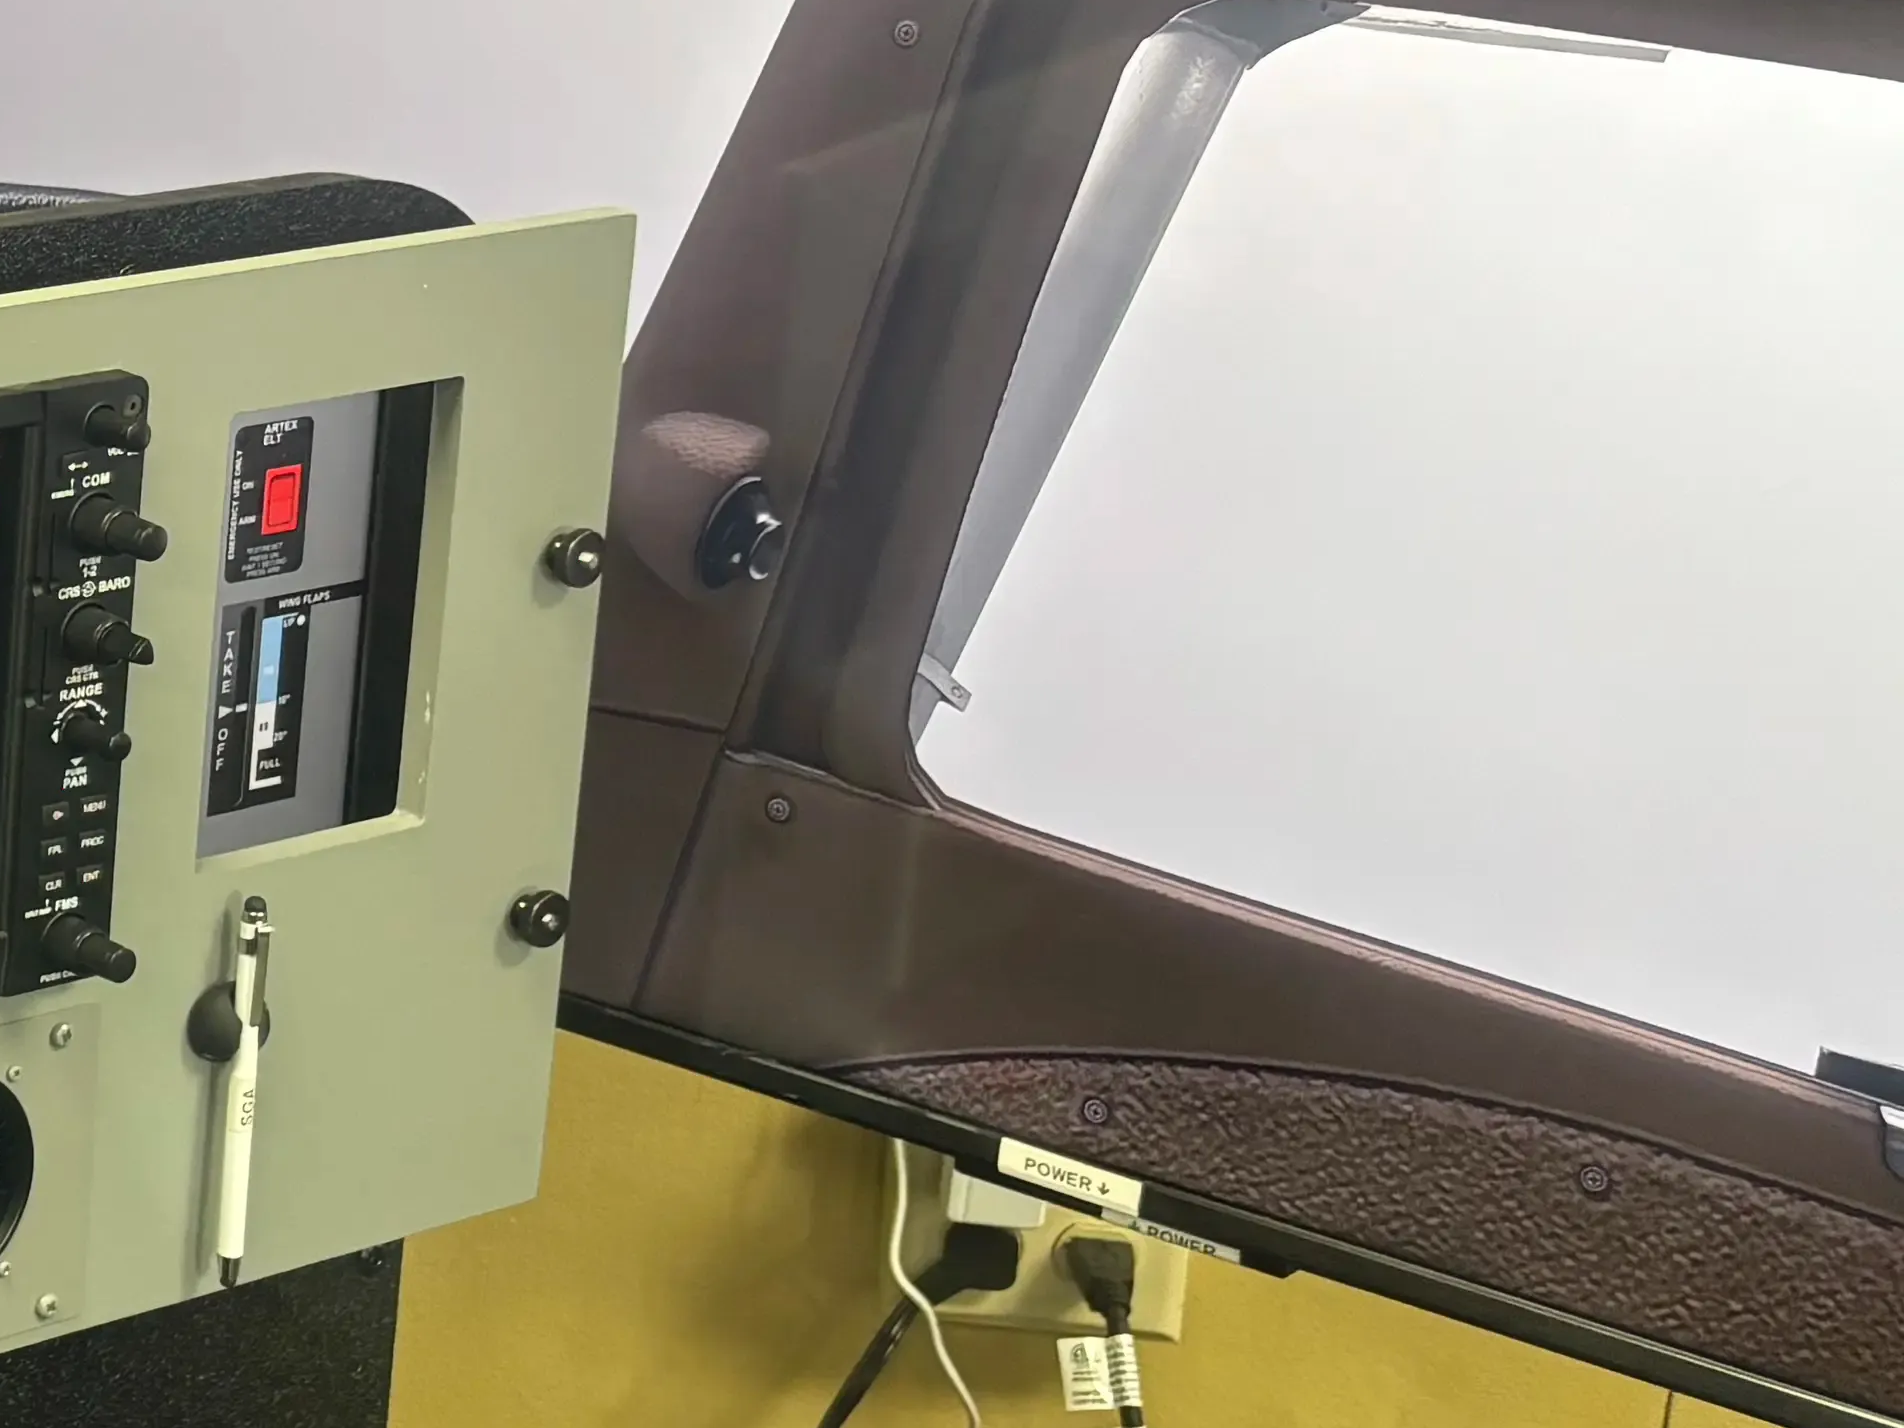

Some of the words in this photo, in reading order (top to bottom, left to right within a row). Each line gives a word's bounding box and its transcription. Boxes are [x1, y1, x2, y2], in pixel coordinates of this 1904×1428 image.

[265, 420, 298, 434] ARTEX
[263, 433, 282, 445] ELT
[303, 590, 330, 605] FLAPS
[59, 682, 103, 702] RANGE
[259, 758, 280, 770] FULL
[1024, 1157, 1091, 1192] POWER
